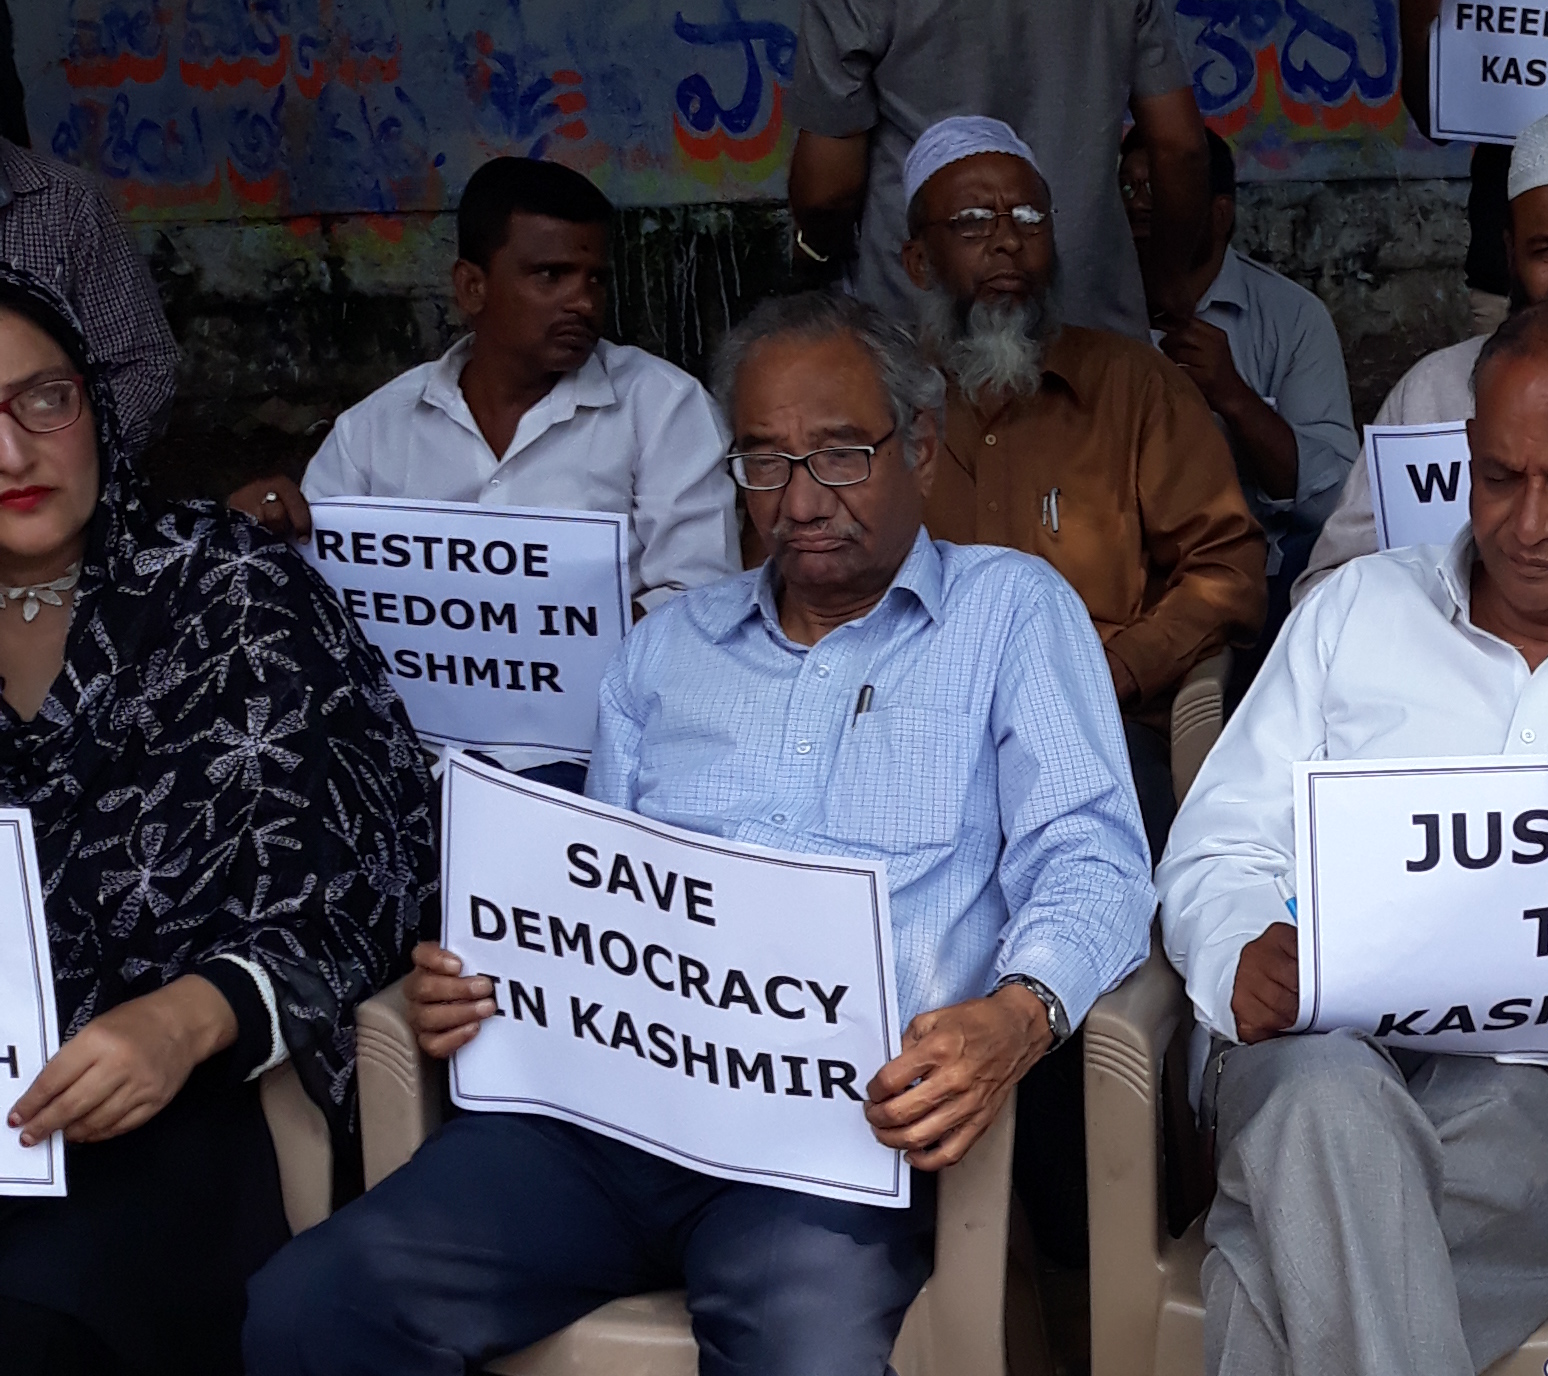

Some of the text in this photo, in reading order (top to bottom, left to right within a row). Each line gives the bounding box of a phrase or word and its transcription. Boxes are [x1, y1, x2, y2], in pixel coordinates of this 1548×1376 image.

[1406, 459, 1472, 504] W
[314, 528, 550, 578] RESTROE
[537, 604, 599, 638] IN
[566, 842, 717, 927] SAVE
[469, 893, 850, 1025] DEMOCRACY
[476, 972, 870, 1102] IN KASHMIR
